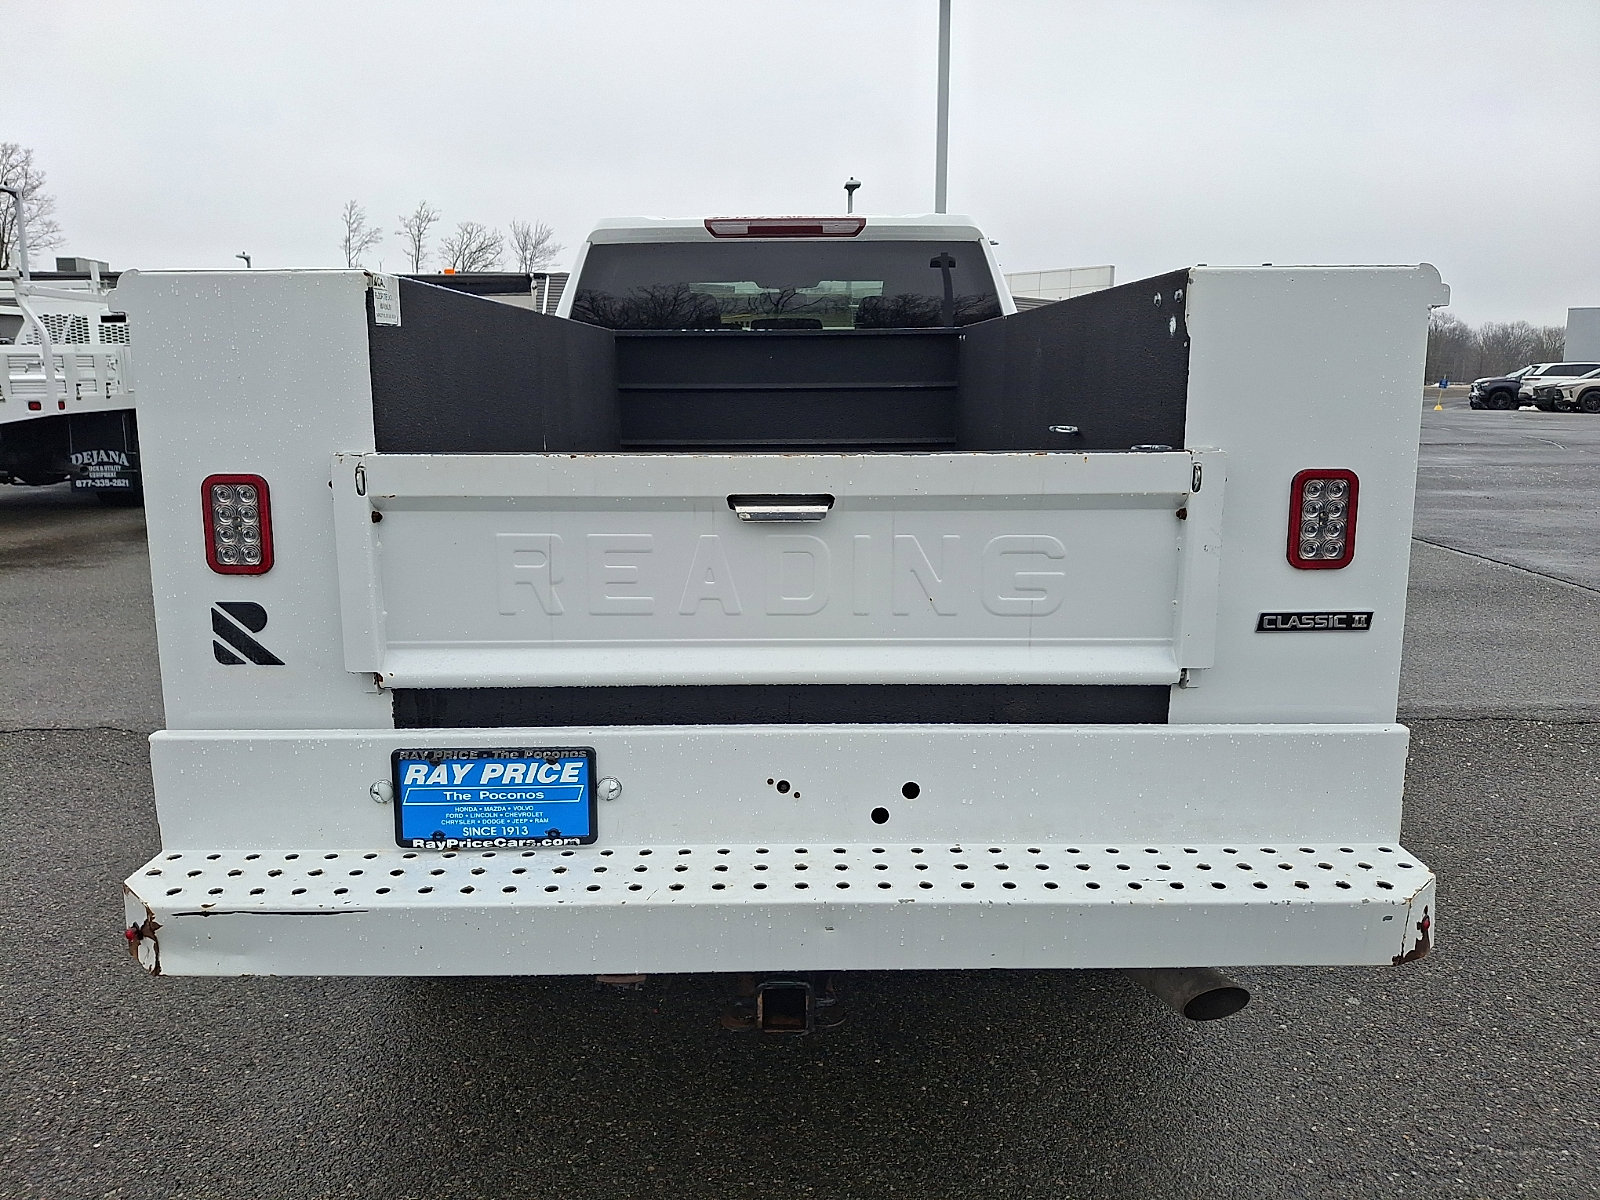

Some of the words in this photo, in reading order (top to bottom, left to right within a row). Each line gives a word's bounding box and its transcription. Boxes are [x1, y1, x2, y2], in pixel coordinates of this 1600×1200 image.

[70, 449, 130, 467] DEJANA
[497, 533, 1066, 617] READING
[1263, 615, 1347, 629] CLASSIC
[1352, 614, 1368, 628] II
[399, 750, 428, 760] RAY
[432, 750, 479, 760] PRICE
[492, 750, 519, 760] The
[524, 750, 587, 760] Poconos
[404, 763, 475, 785] RAY
[480, 762, 584, 785] PRICE
[443, 791, 472, 801] The
[479, 790, 545, 800] Poconos
[462, 826, 497, 837] SINCE
[501, 826, 529, 836] 1913
[412, 837, 581, 850] RayPriceCars.com
